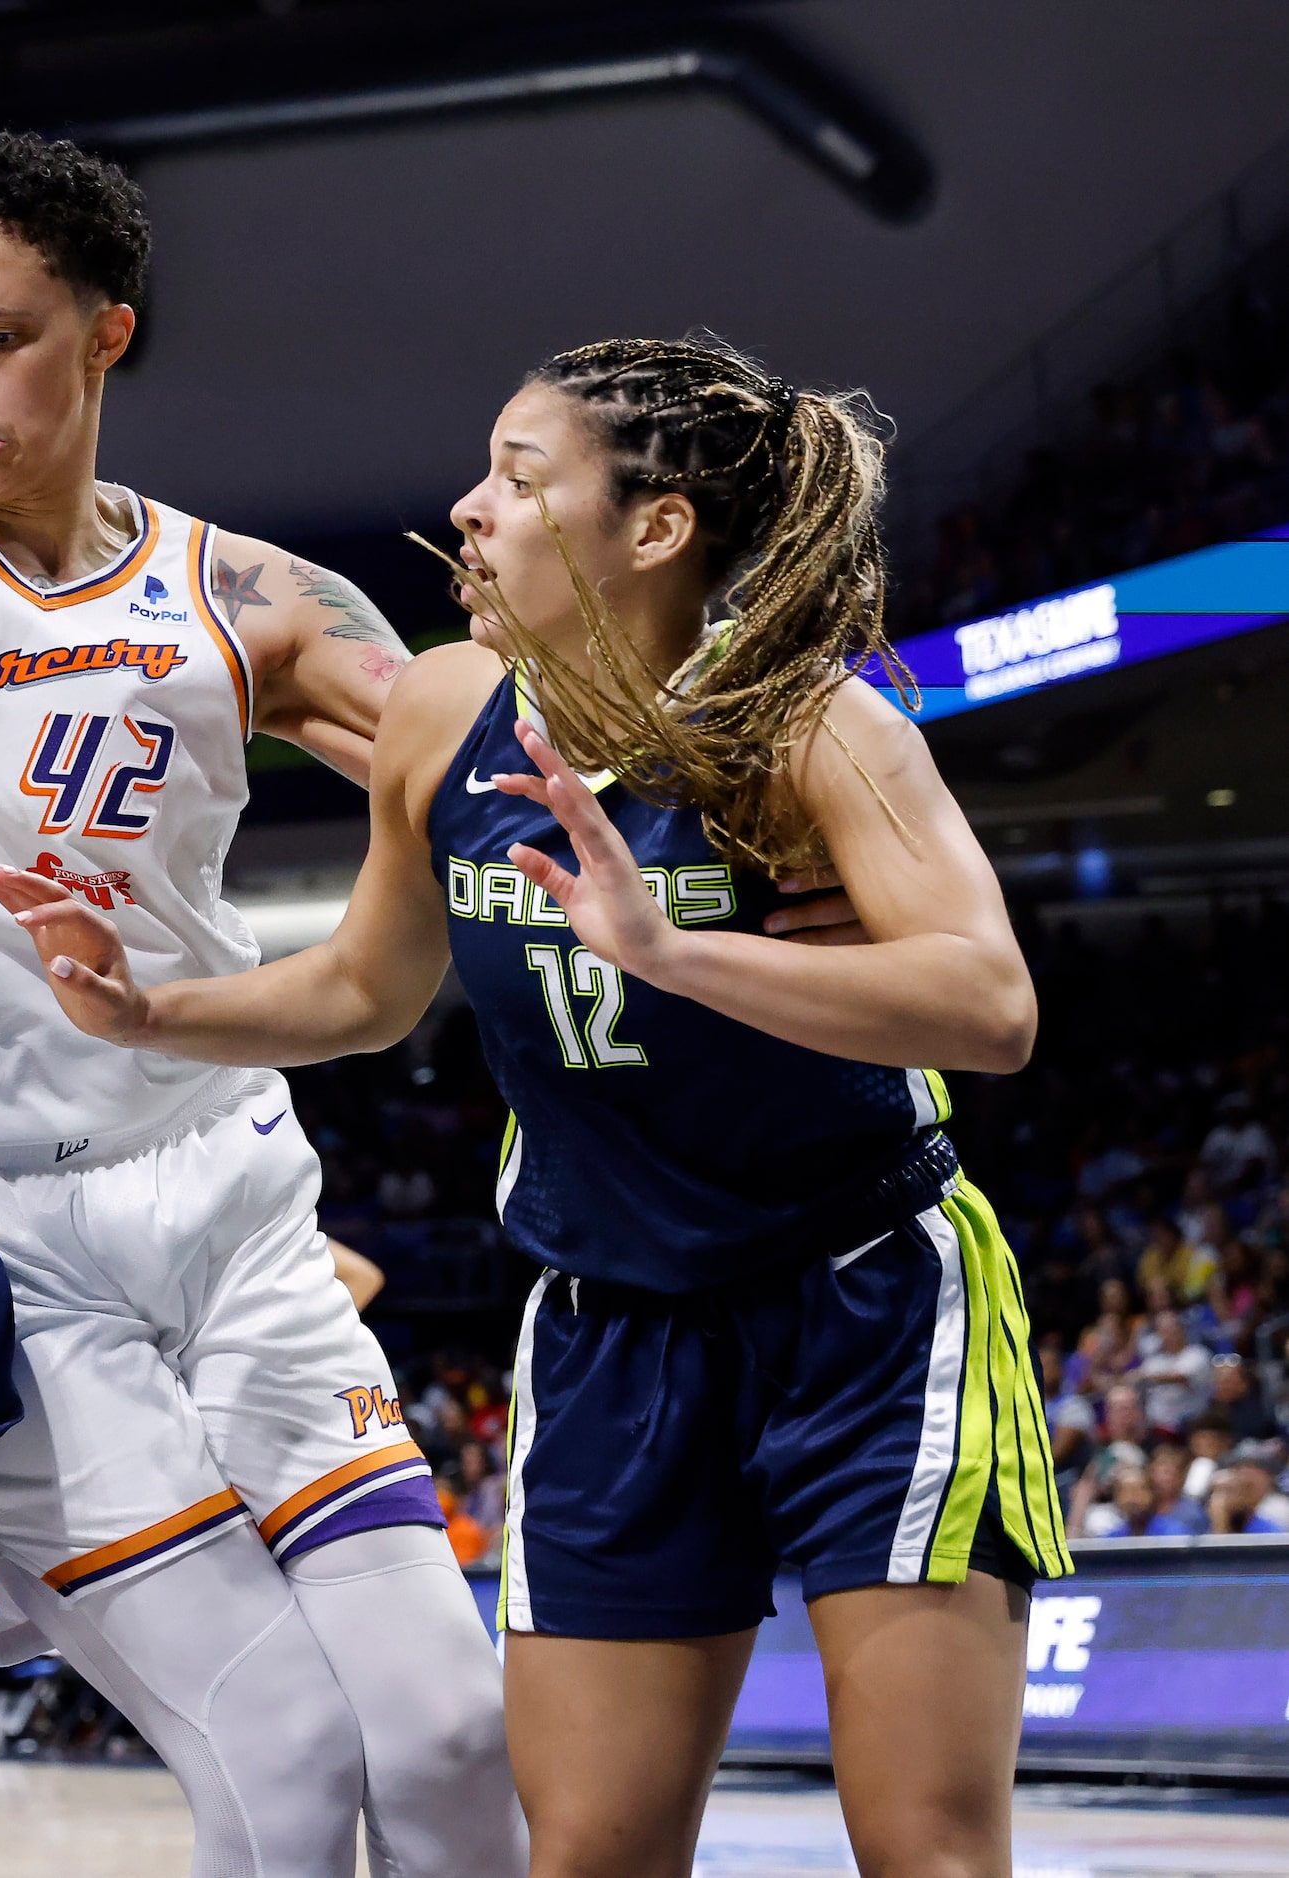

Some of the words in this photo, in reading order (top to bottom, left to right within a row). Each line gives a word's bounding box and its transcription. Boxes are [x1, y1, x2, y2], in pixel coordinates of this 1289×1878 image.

[130, 603, 187, 621] PayPal
[19, 711, 175, 839] 42
[55, 869, 85, 883] FOOD
[525, 944, 648, 1068] 12
